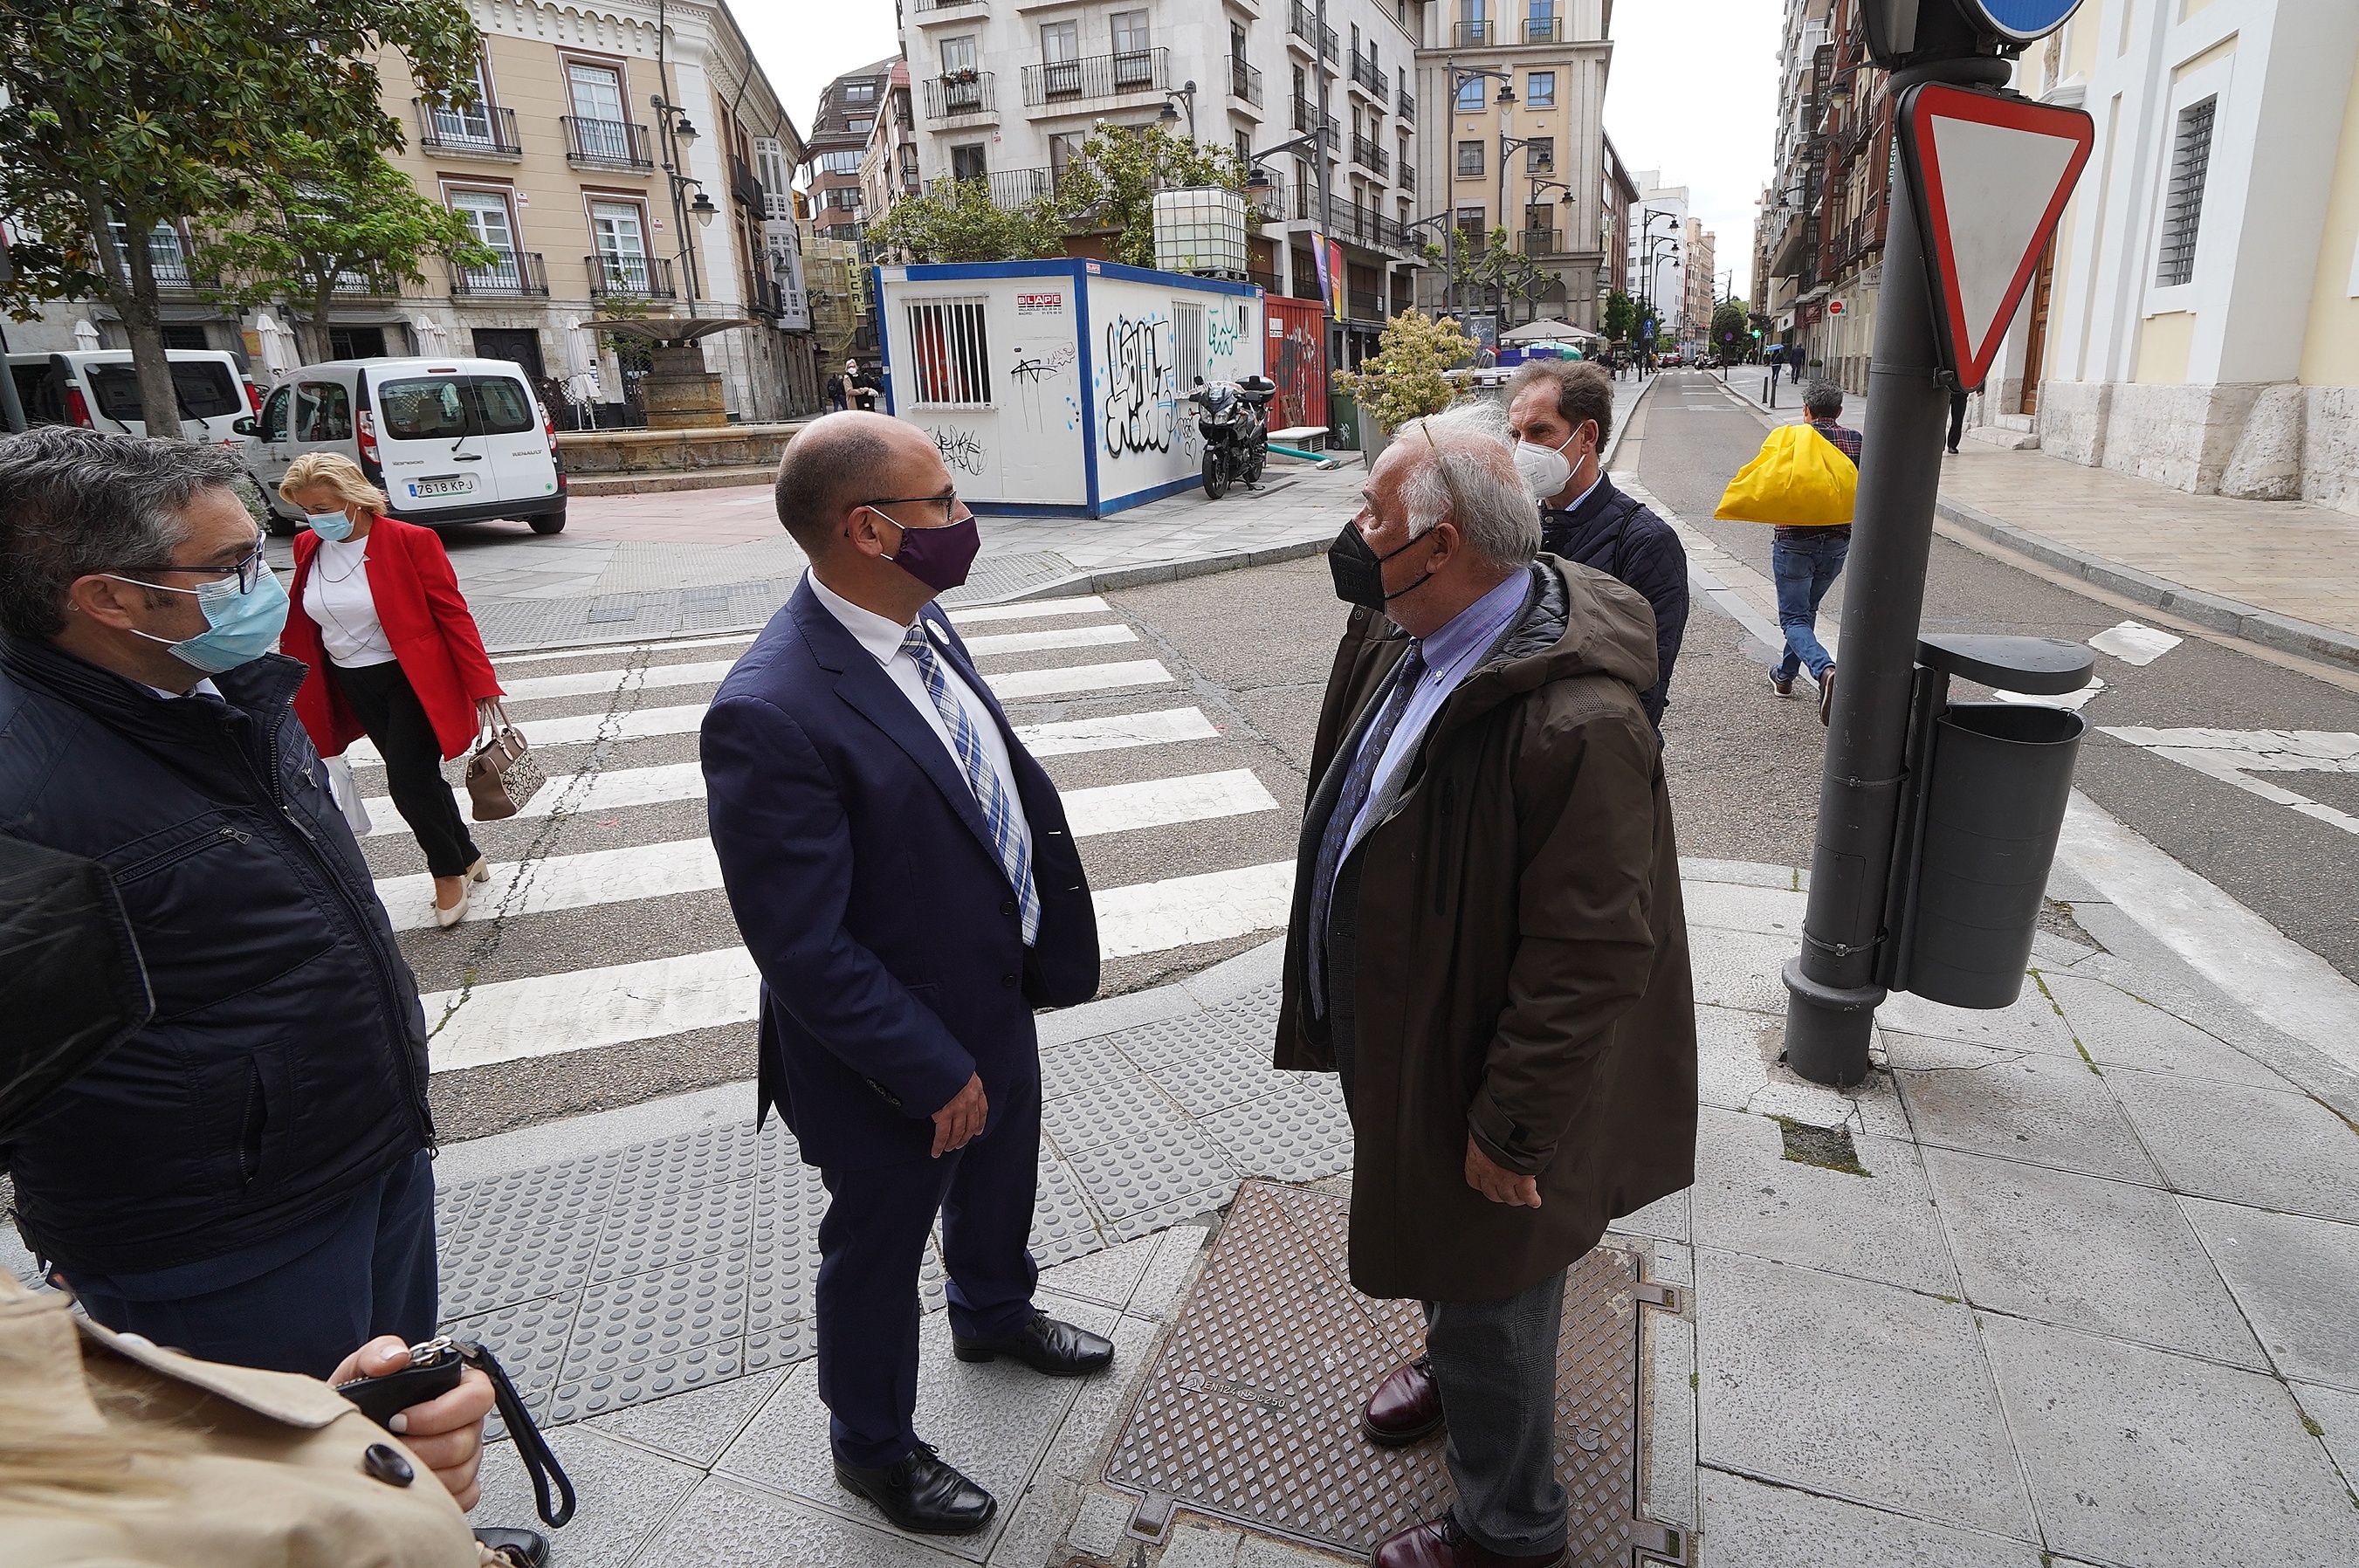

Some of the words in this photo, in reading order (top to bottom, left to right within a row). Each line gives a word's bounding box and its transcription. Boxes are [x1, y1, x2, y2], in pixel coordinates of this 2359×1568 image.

[1888, 135, 1897, 183] SEGUROS
[847, 258, 862, 313] ALCAL
[1017, 295, 1062, 305] BLAPE
[417, 482, 448, 495] 7618
[451, 480, 473, 492] KPJ
